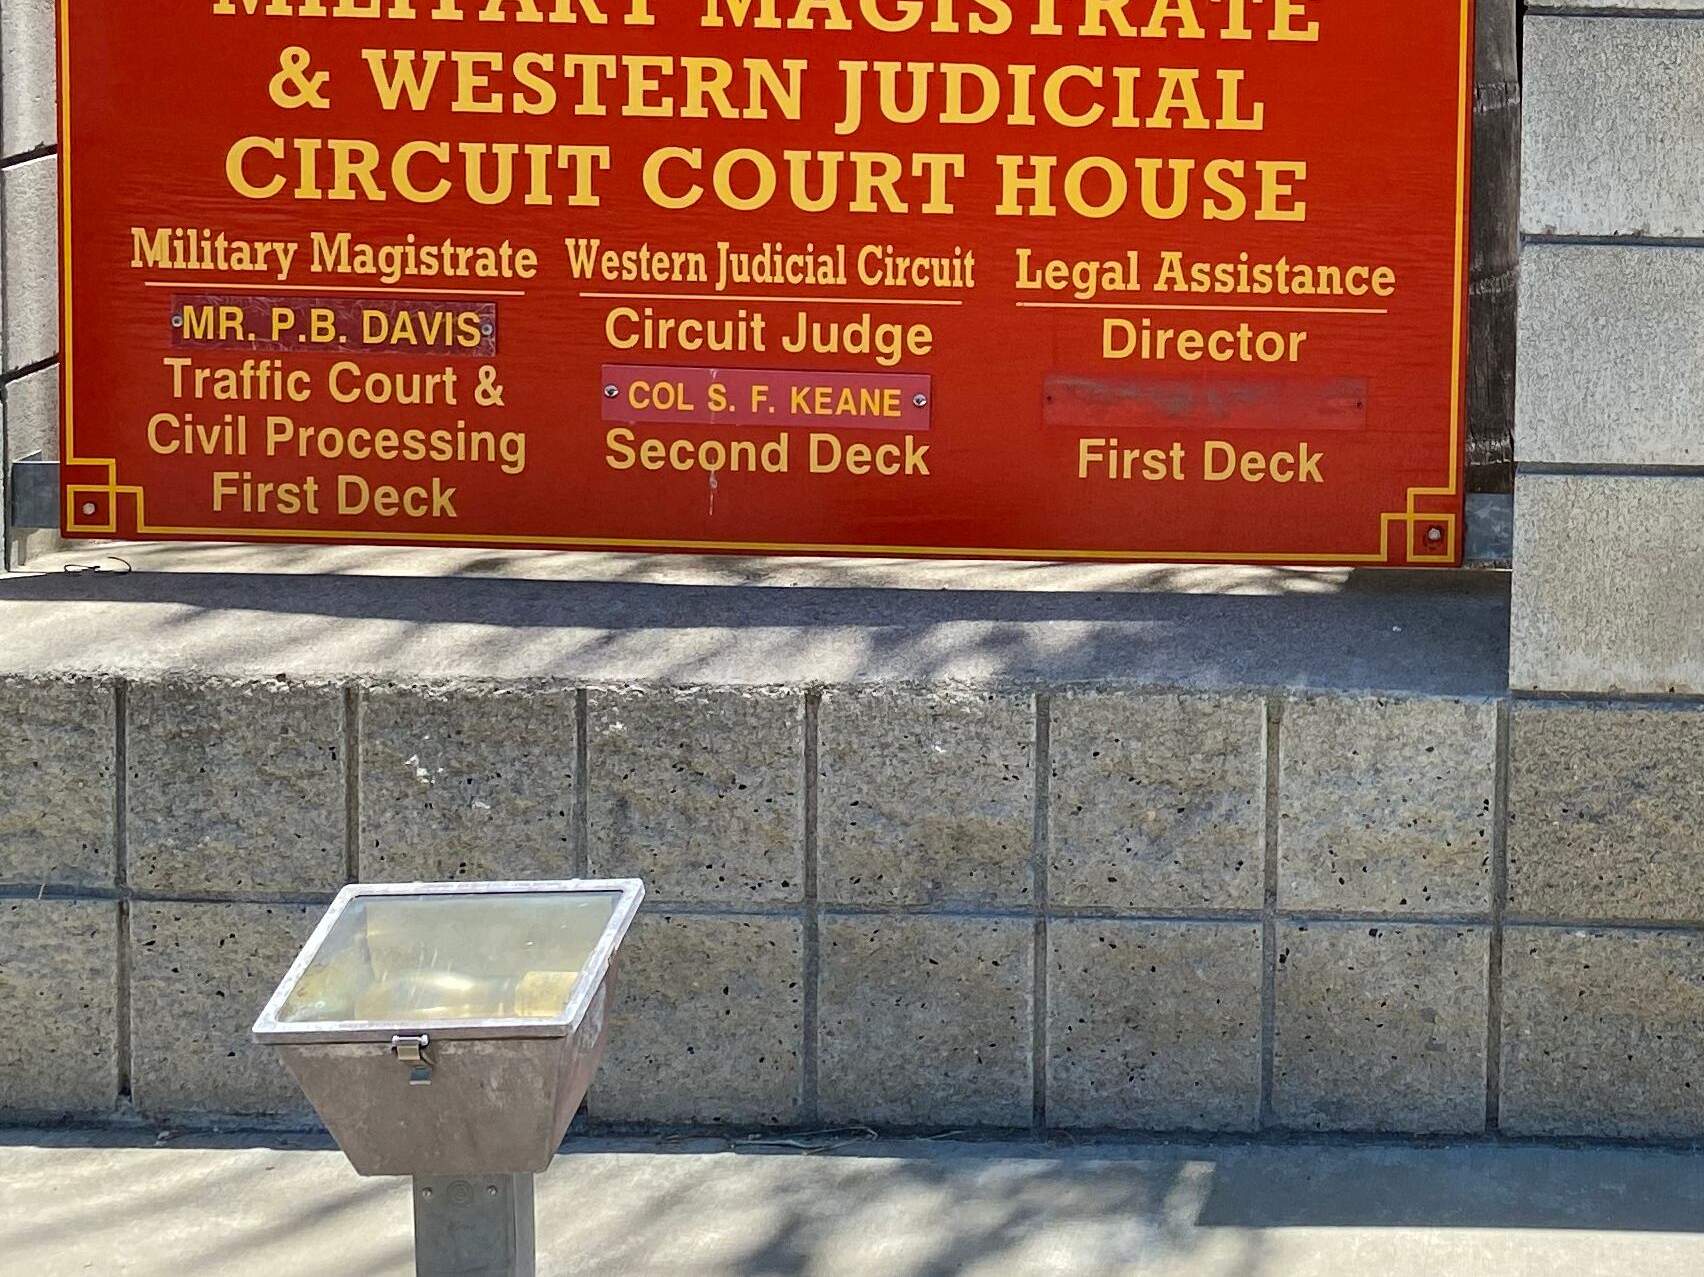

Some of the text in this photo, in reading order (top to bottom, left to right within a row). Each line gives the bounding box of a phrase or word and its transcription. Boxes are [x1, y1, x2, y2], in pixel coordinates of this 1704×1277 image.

[269, 47, 1263, 134] & WESTERN JUDICIAL
[226, 136, 1306, 221] CIRCUIT COURT HOUSE
[131, 228, 537, 283] Military Magistrate
[565, 238, 974, 291] Western Judicial Circuit
[1016, 249, 1395, 299] Legal Assistance
[184, 306, 480, 346] MR. P.B. DAVIS
[606, 307, 932, 365] Circuit Judge
[1103, 319, 1306, 361] Director
[164, 358, 504, 405] Traffic Court &
[629, 381, 900, 416] COL S. F. KEANE
[148, 413, 525, 473] Civil Processing
[606, 428, 929, 475] Second Deck
[1079, 439, 1323, 482] First Deck
[214, 472, 456, 516] First Deck
